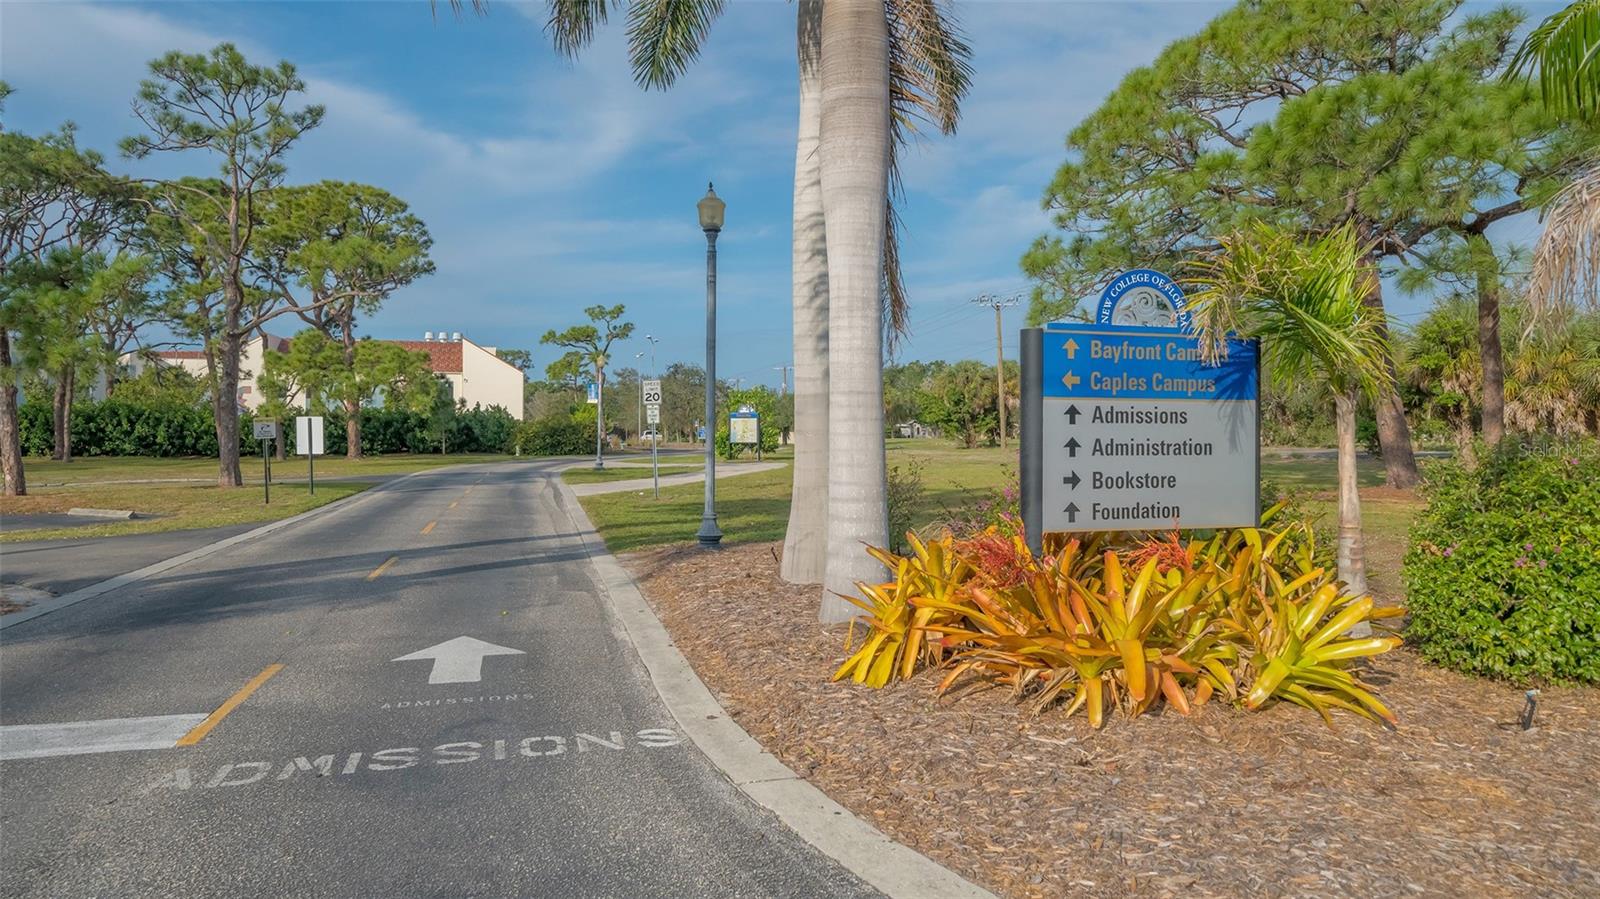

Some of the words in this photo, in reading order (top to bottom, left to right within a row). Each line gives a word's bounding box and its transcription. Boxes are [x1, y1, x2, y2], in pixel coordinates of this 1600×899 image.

[1101, 298, 1113, 324] NEW
[1111, 273, 1150, 297] COLLEGE
[1151, 275, 1166, 288] OF
[1090, 340, 1161, 363] Bayfront
[1166, 342, 1229, 363] Cam
[1090, 371, 1147, 395] Caples
[1152, 373, 1216, 396] Campus
[645, 392, 660, 402] 20
[1092, 405, 1188, 424] Admissions
[1092, 438, 1213, 457] Administration
[1092, 471, 1176, 489] Bookstore
[1092, 501, 1180, 521] Foundation
[381, 693, 534, 709] ADMISSIONS
[145, 727, 682, 791] ADMISSIONS
